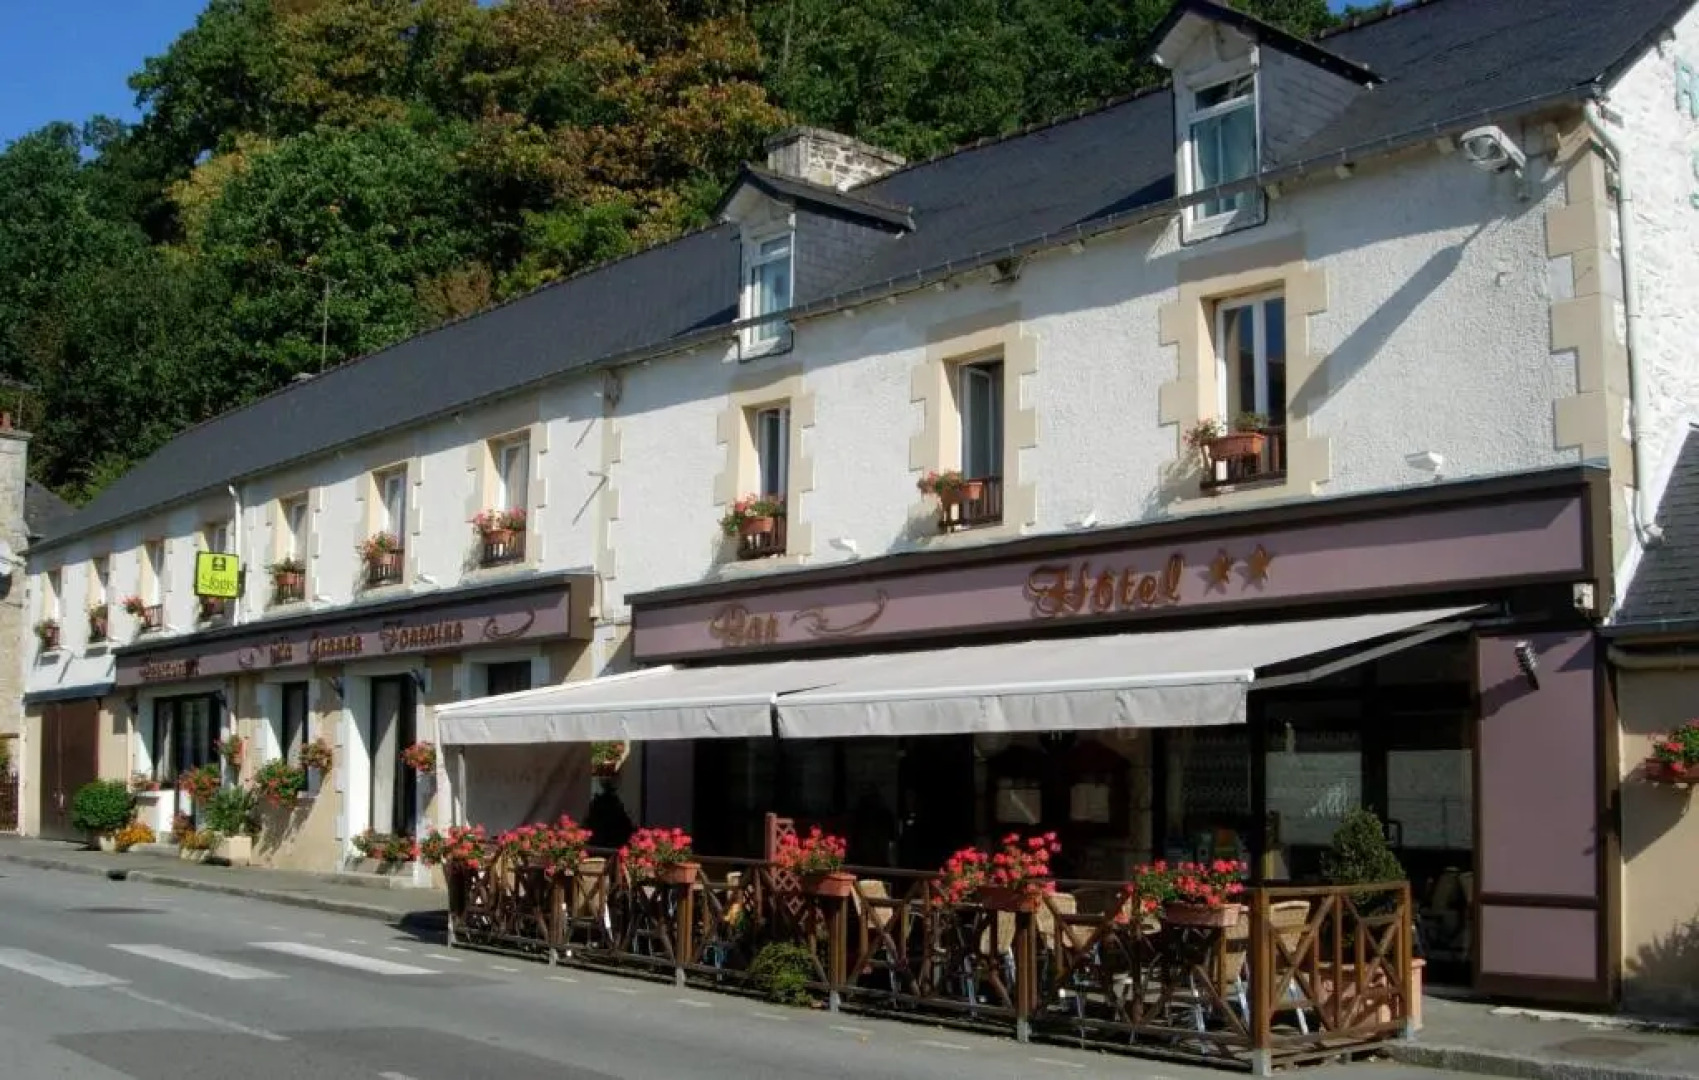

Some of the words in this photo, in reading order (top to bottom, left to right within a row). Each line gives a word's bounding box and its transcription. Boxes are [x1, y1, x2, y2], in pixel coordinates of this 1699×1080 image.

[710, 604, 778, 646] Bar
[1026, 552, 1184, 615] Hôtel
[379, 619, 464, 651] Fontaine
